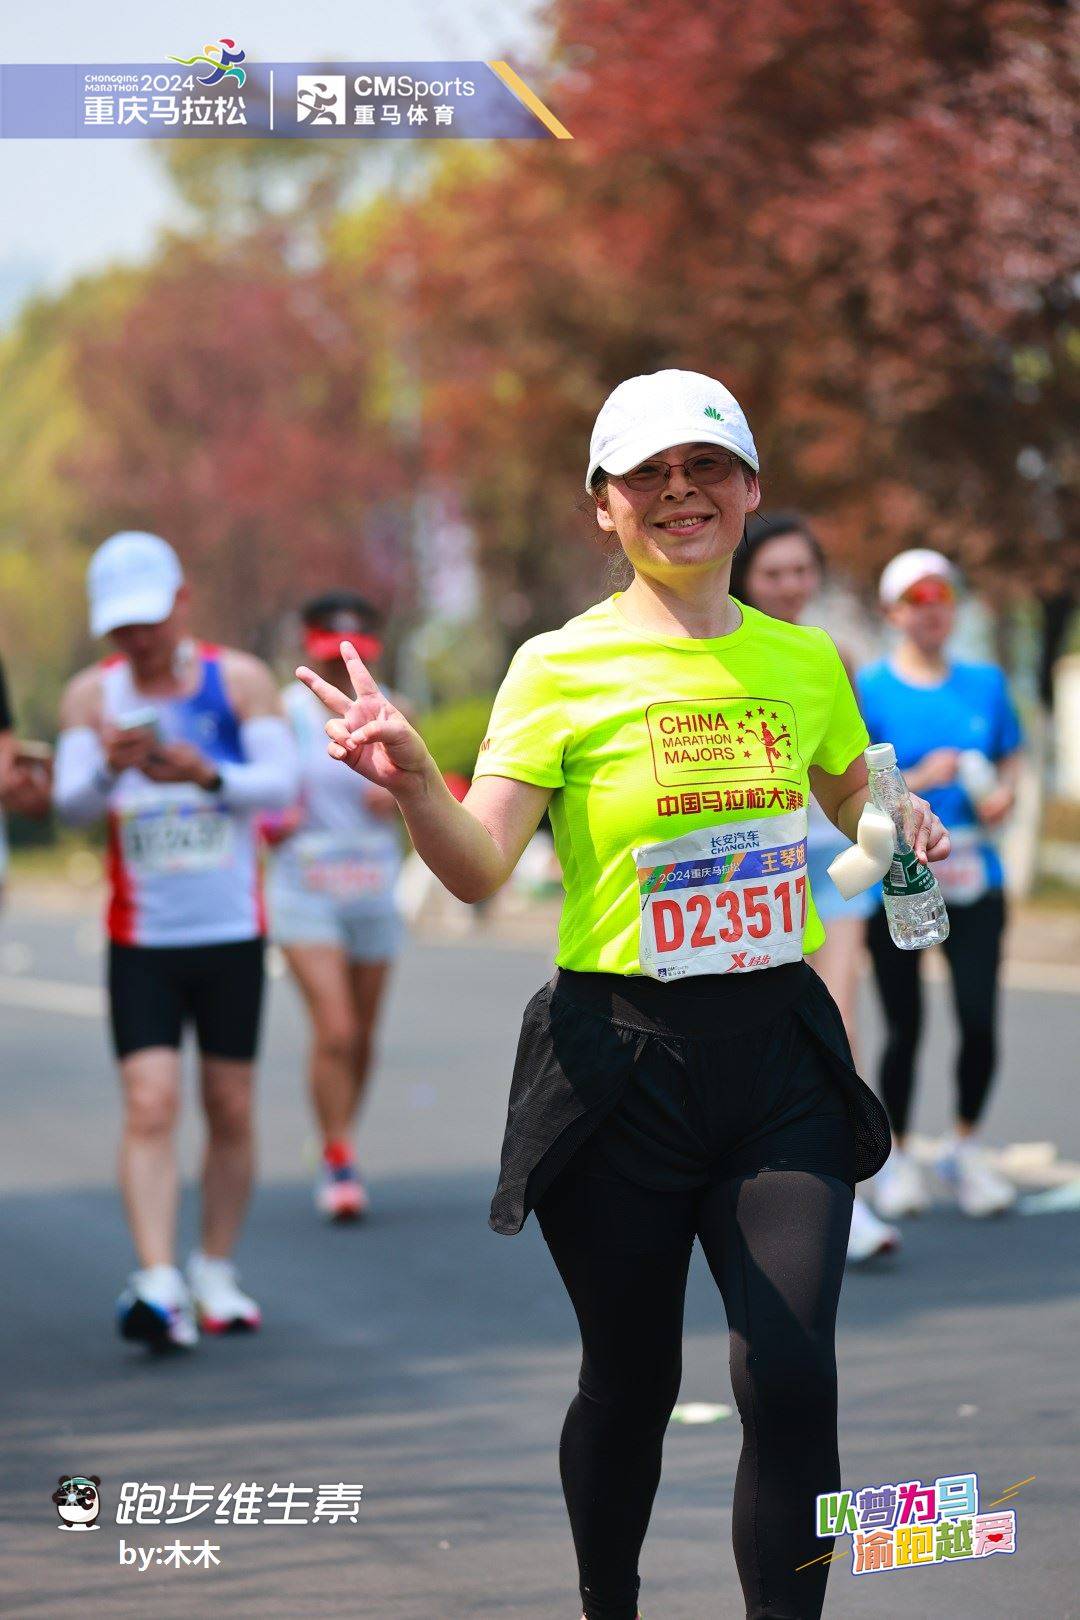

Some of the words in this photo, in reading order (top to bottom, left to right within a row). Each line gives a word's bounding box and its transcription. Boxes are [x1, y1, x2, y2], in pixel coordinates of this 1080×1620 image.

[659, 713, 729, 734] CHINA
[662, 733, 732, 748] MARATHON
[664, 747, 735, 764] MAJORS
[710, 830, 760, 847] 长安汽车
[711, 841, 760, 855] CHANGAN
[651, 874, 807, 953] D23517
